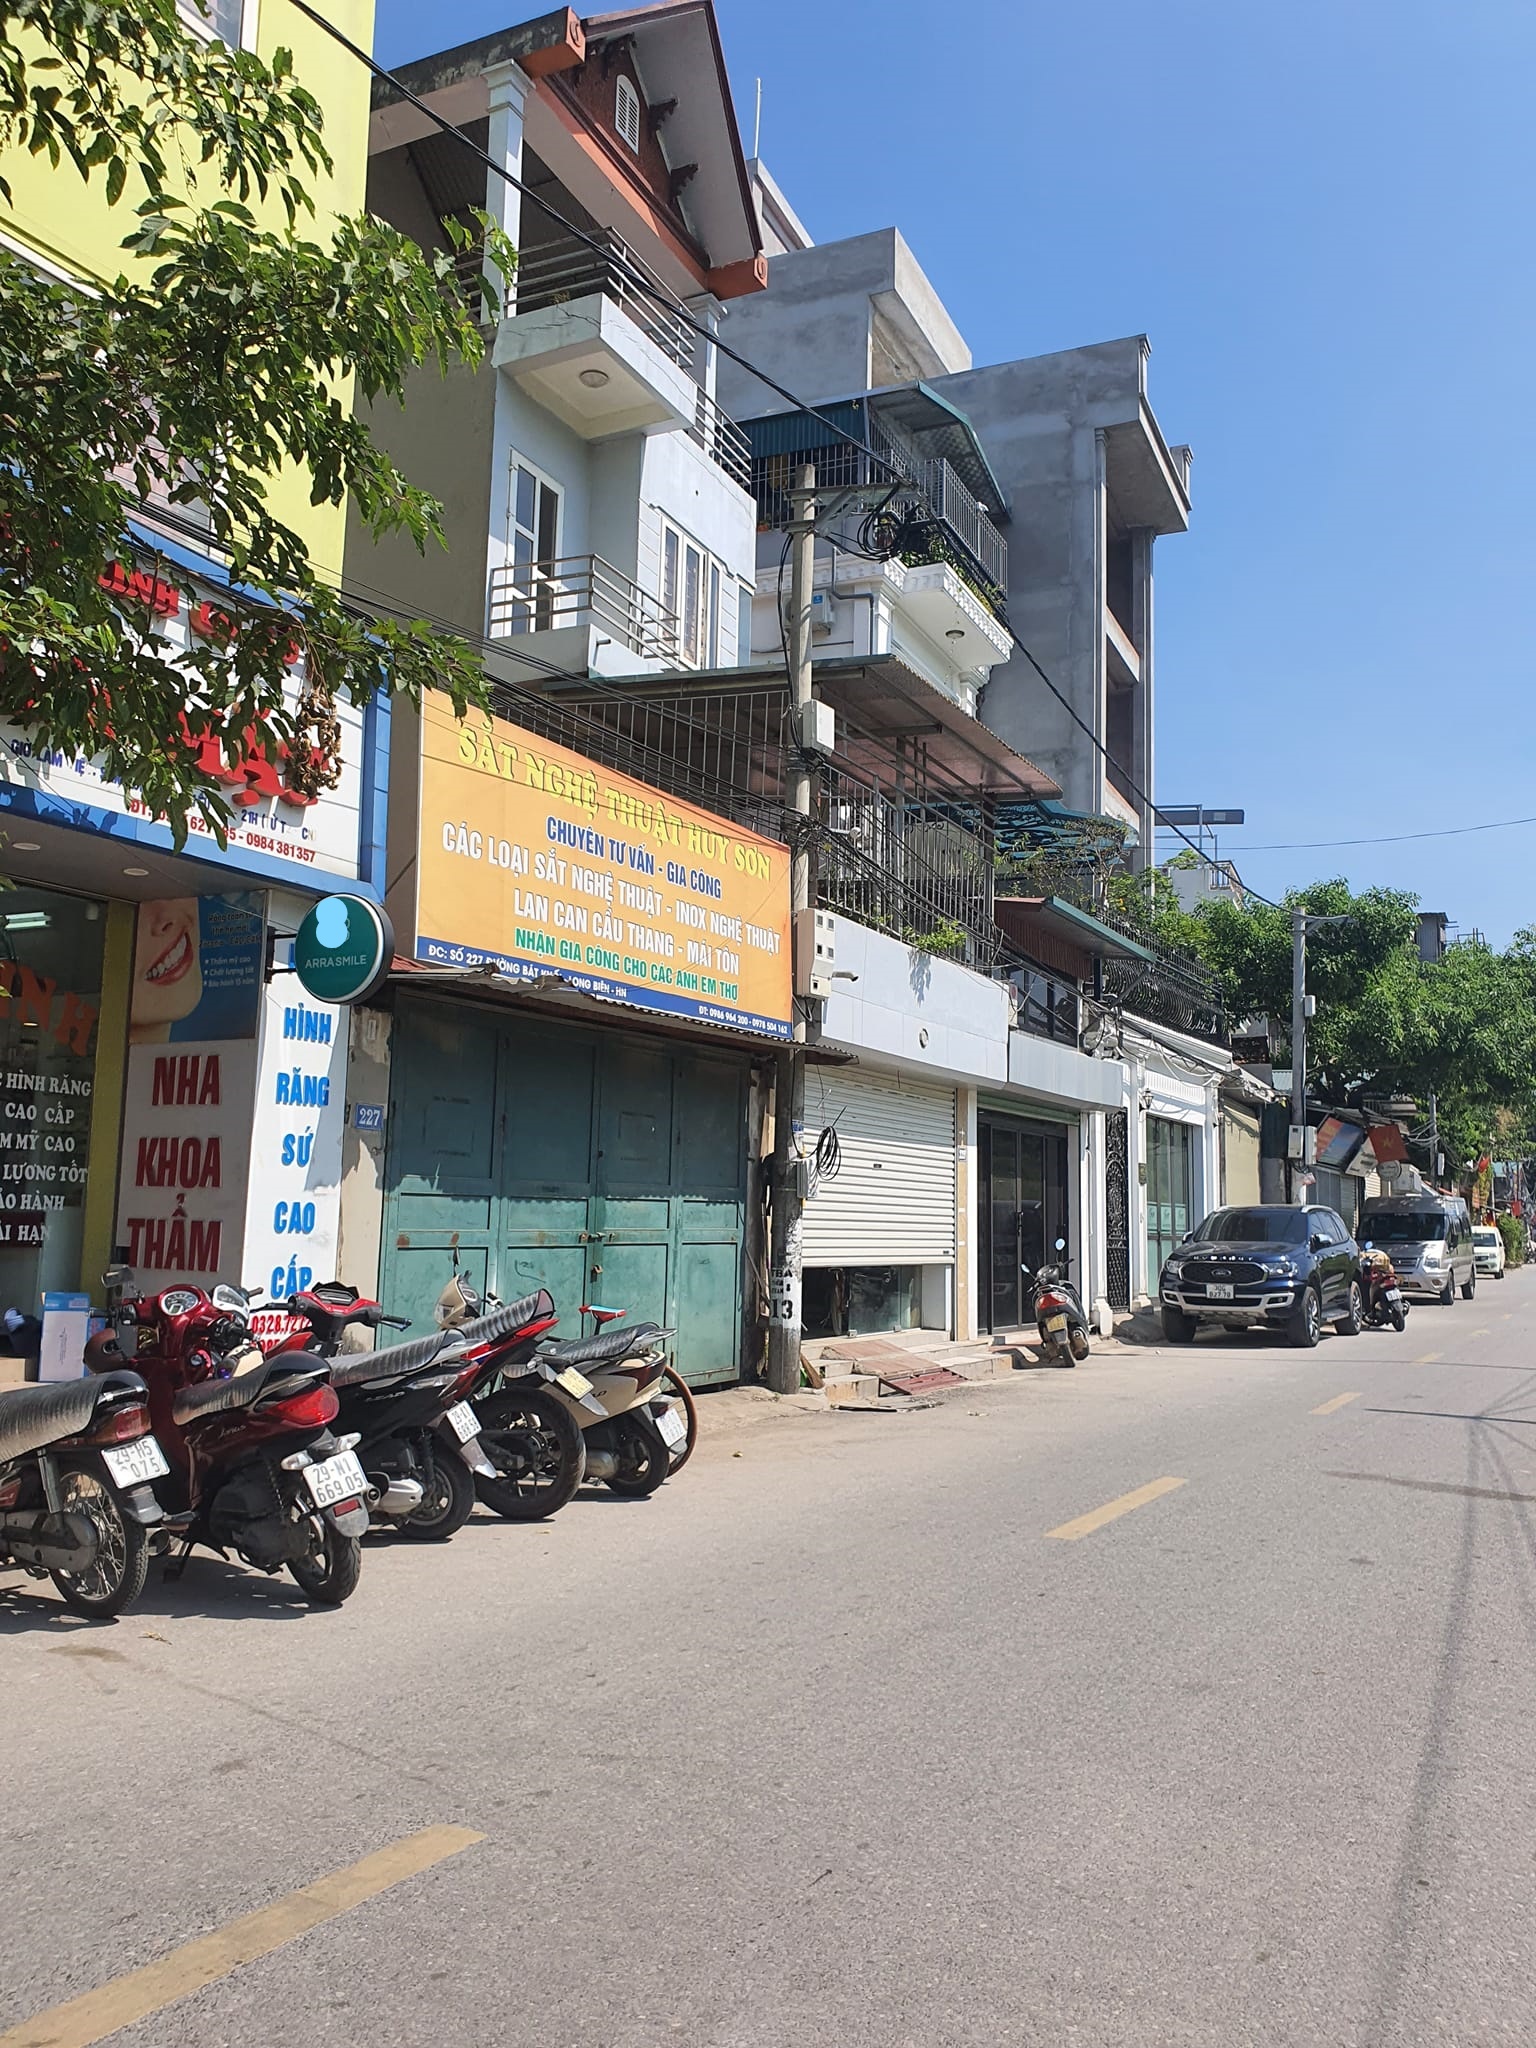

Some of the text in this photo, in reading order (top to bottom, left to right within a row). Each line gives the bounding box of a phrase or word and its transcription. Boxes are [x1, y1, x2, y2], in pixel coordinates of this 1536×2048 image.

[525, 753, 600, 821] NGHỆ
[605, 787, 683, 848] THUẬT
[688, 822, 731, 865] HUY
[735, 843, 772, 881] SƠN
[546, 816, 605, 858] CHUYÊN
[608, 838, 626, 864] TƯ
[629, 844, 655, 875] VẤN
[667, 861, 686, 887] GIA
[690, 869, 721, 899] CÔNG
[442, 821, 483, 860] CÁC
[488, 836, 529, 878] LOẠI
[534, 847, 568, 887] SẮT
[571, 864, 614, 906] NGHỆ
[618, 879, 663, 918] THUẬT
[676, 900, 707, 931] INOX
[710, 911, 743, 946] NGHỆ
[745, 922, 780, 956] THUẬT
[514, 888, 549, 923] LAN
[554, 900, 588, 933] CAN
[592, 908, 623, 943] CẦU
[626, 921, 674, 958] THANG
[687, 938, 712, 968] MÁI
[715, 946, 740, 976] TÔN
[429, 944, 447, 959] ĐC:
[449, 947, 465, 961] SỐ
[466, 952, 483, 965] 227
[515, 928, 738, 1004] NHẬN GIA CÔNG CHO CÁC ANH EM THỢ
[6, 1069, 46, 1091] HÌNH
[49, 1075, 91, 1097] RĂNG
[152, 1055, 220, 1106] NHA
[276, 1067, 330, 1108] RĂNG
[5, 1101, 75, 1124] CAO CẤP
[359, 1106, 381, 1127] 227
[16, 1130, 39, 1150] MỸ
[44, 1136, 75, 1152] CAO
[281, 1126, 314, 1167] SỨ
[59, 1160, 88, 1183] TỐT
[136, 1137, 221, 1188] KHOA
[20, 1190, 65, 1212] HÀNH
[274, 1201, 315, 1234] CAO
[127, 1193, 222, 1273] THẨM
[271, 1254, 312, 1299] CẤP
[121, 1457, 161, 1478] 075
[316, 1472, 364, 1503] 669.05
